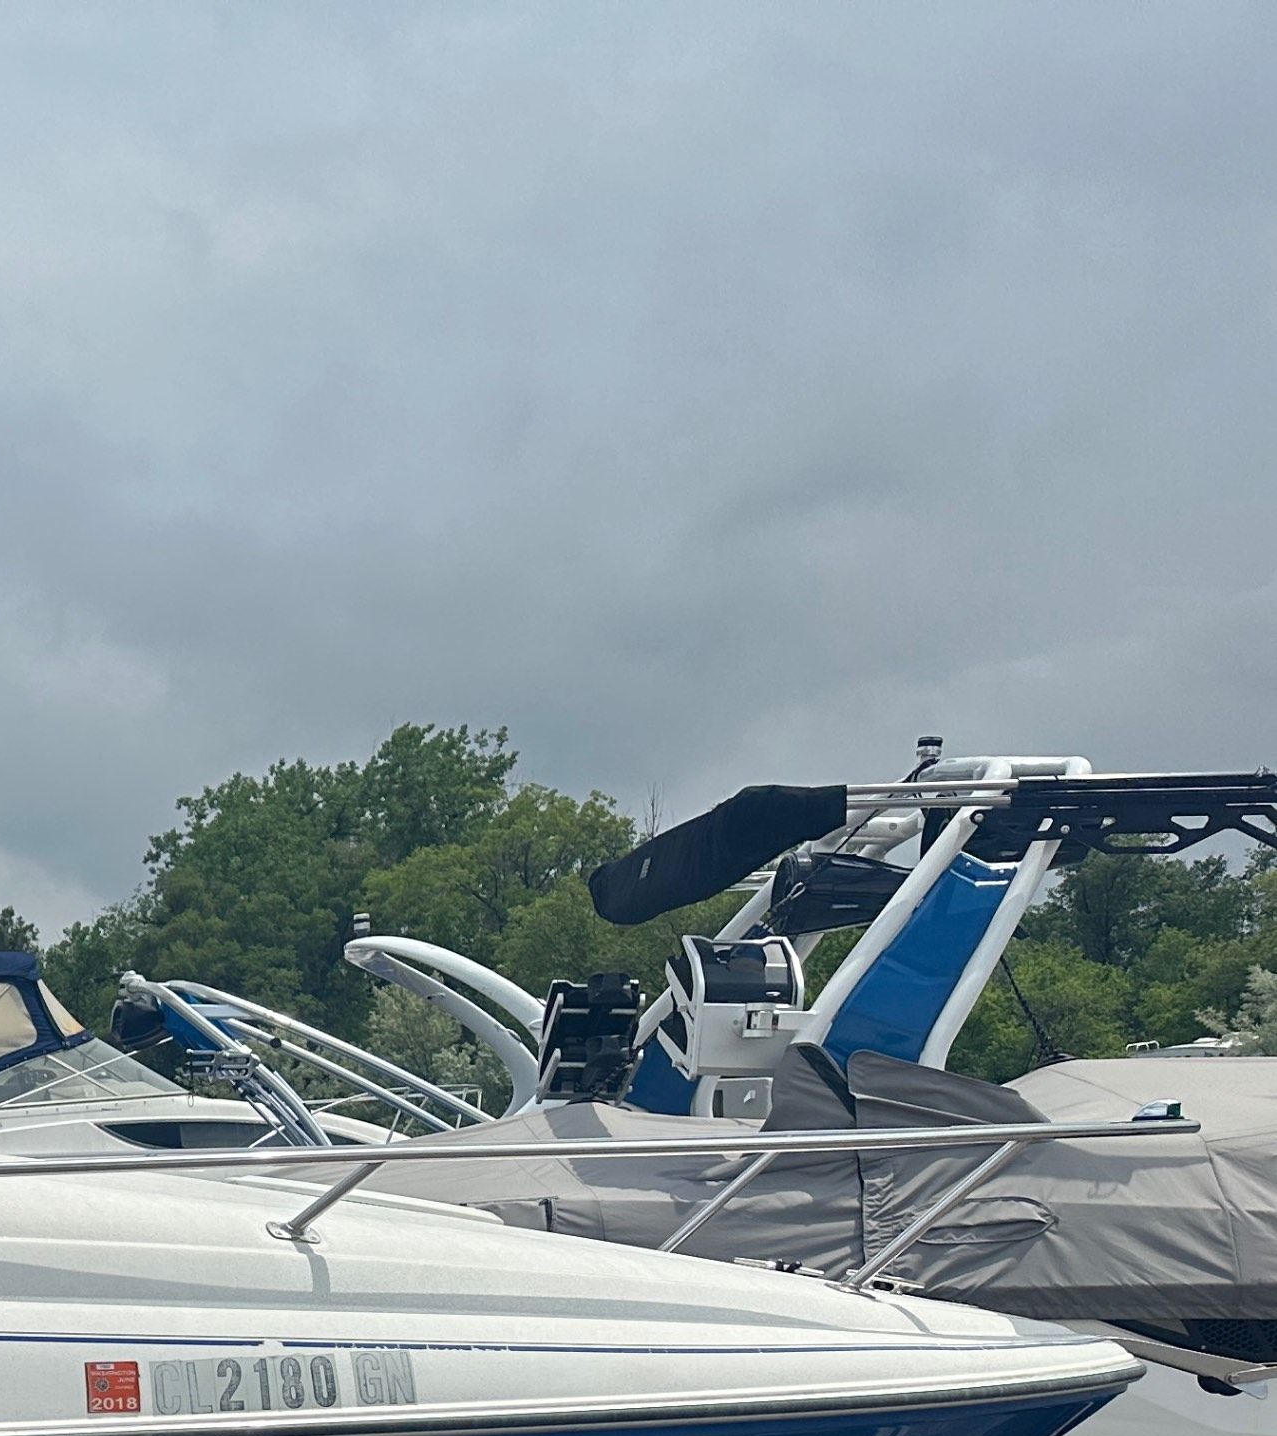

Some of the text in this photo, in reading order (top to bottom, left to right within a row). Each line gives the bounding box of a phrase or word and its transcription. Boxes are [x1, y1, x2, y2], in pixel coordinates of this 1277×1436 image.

[153, 1352, 416, 1415] CL 2180 GN
[90, 1397, 138, 1411] 2018
